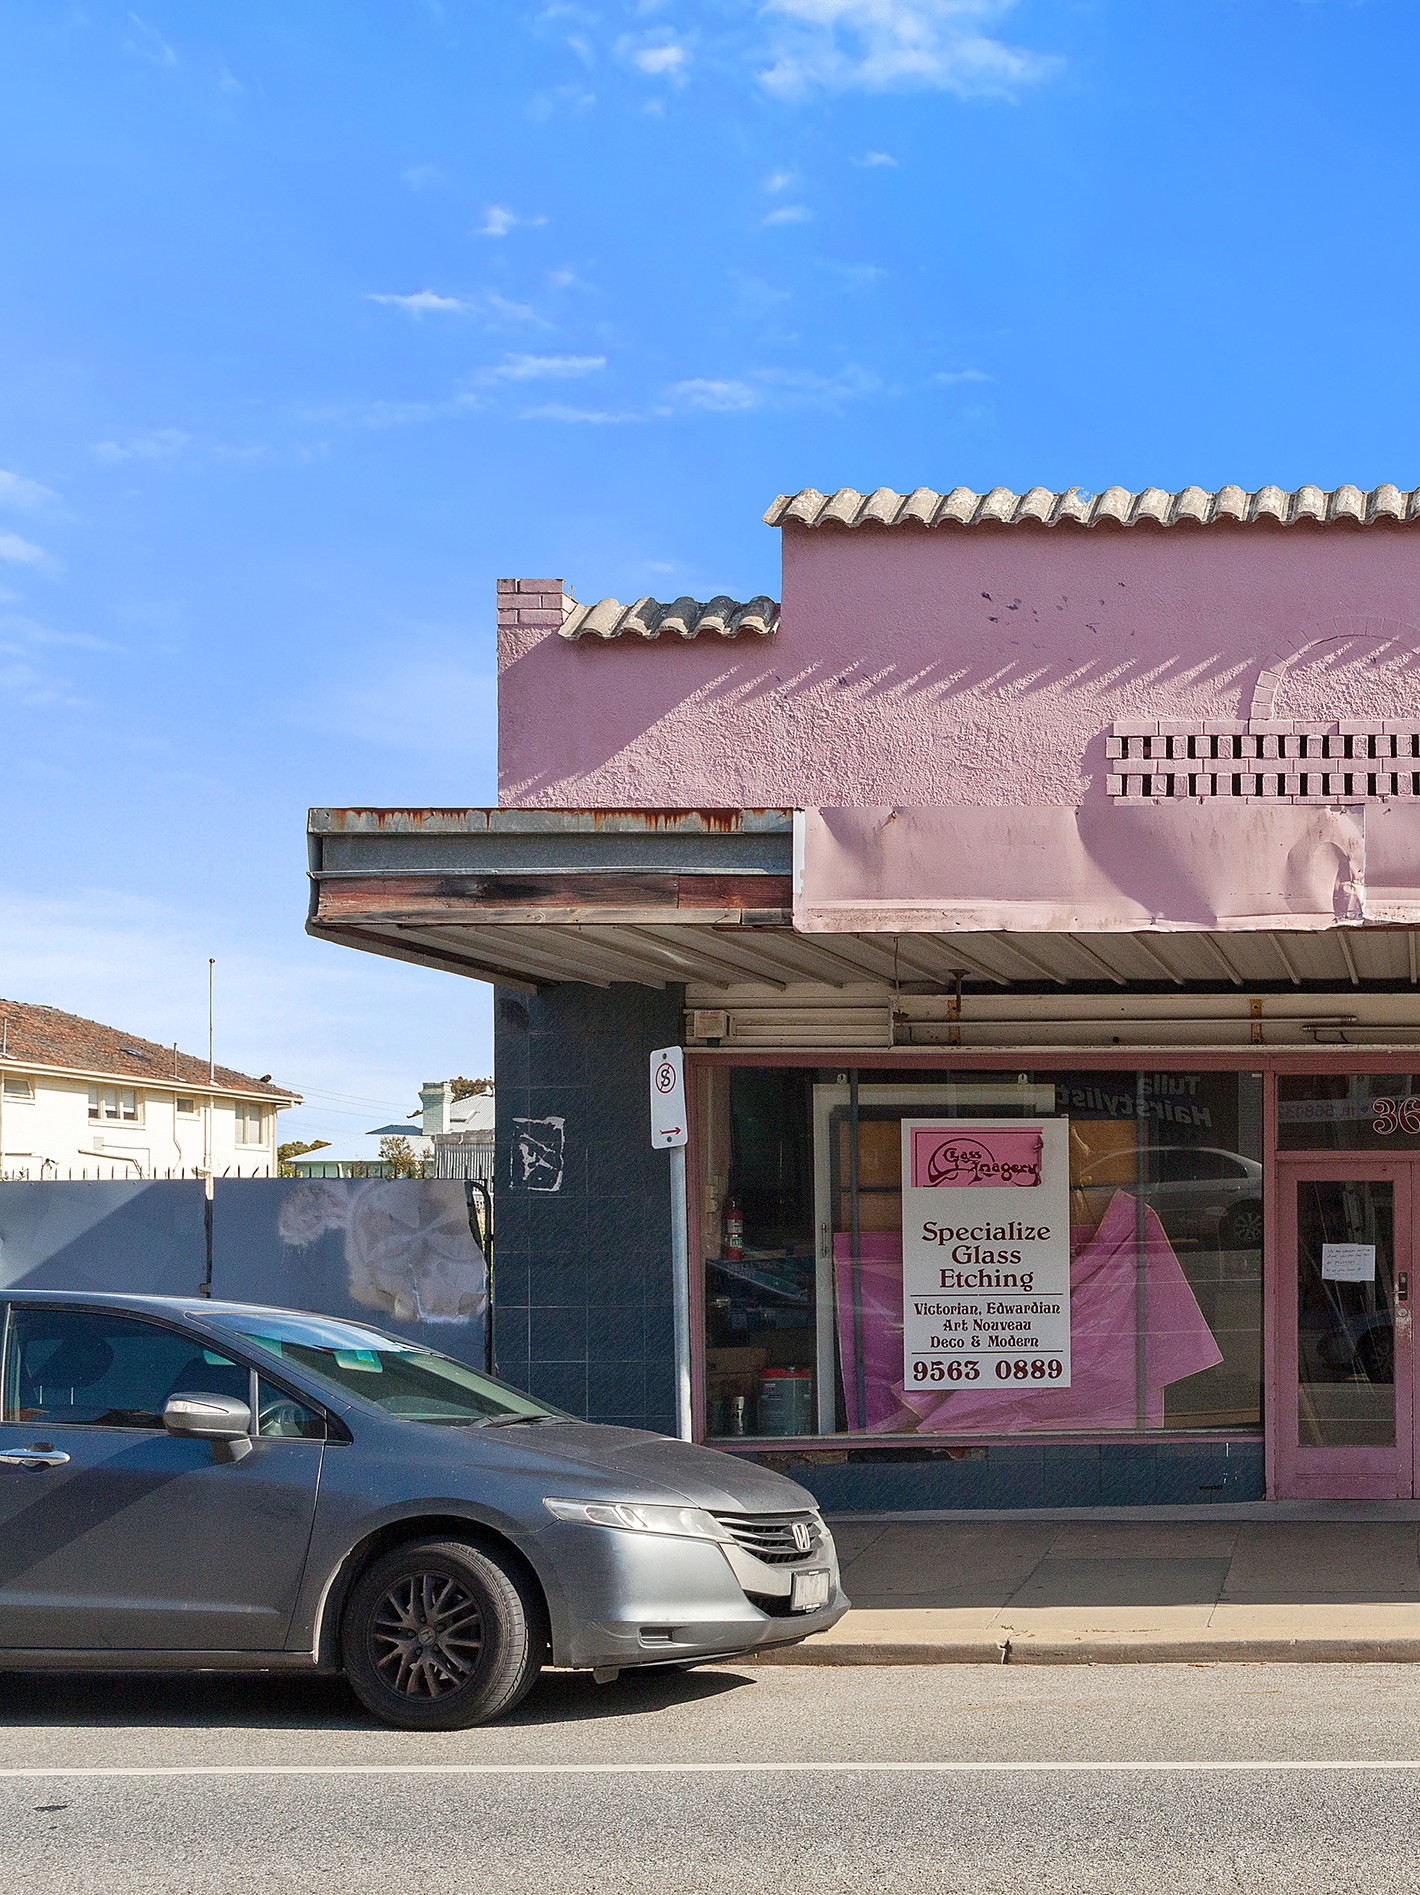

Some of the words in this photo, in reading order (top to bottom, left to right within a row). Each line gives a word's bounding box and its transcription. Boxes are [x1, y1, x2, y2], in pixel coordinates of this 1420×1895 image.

[921, 1221, 1051, 1246] Specialize
[951, 1244, 1022, 1265] Glass
[939, 1268, 1034, 1292] Etching
[914, 1302, 983, 1317] Victorian,
[986, 1301, 1061, 1315] Edwardian
[943, 1319, 968, 1332] Art
[972, 1319, 1032, 1332] Nouveau
[930, 1335, 965, 1349] Deco
[970, 1335, 981, 1348] &
[987, 1335, 1039, 1348] Modern
[913, 1360, 980, 1382] 9563
[995, 1359, 1063, 1380] 0889
